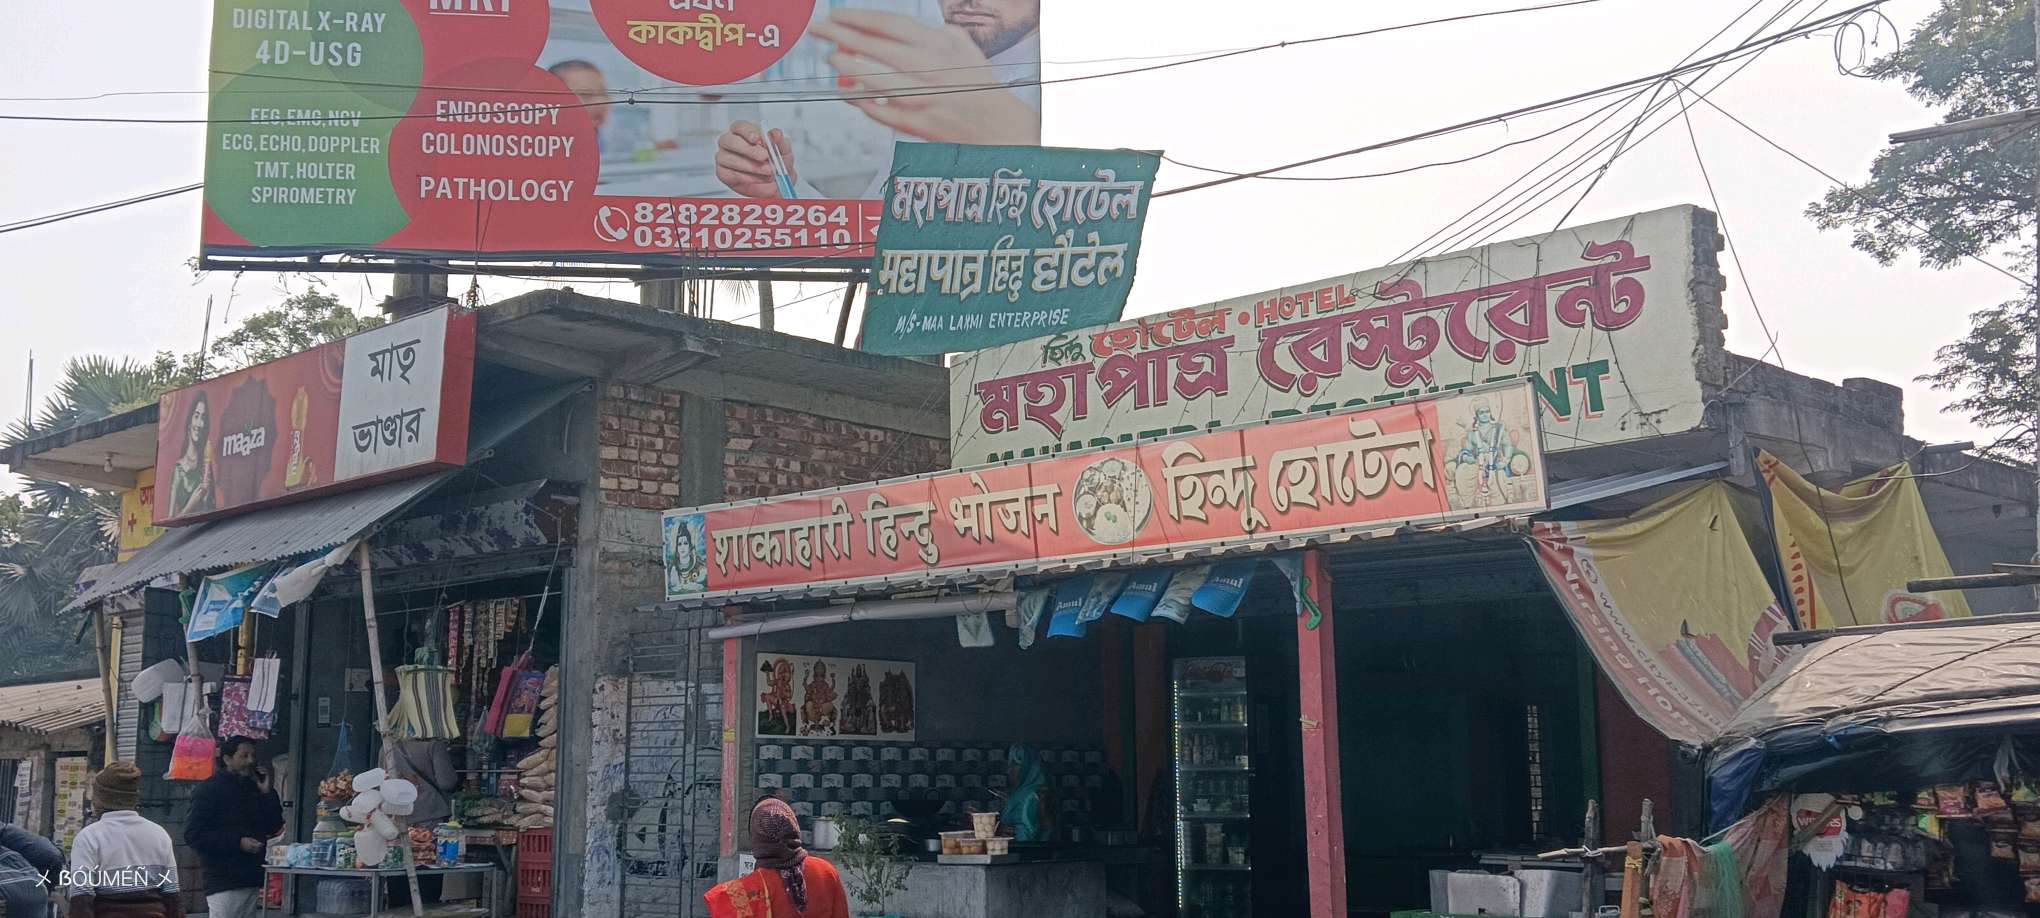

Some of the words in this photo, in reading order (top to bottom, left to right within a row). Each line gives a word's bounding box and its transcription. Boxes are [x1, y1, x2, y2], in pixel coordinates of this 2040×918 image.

[233, 8, 313, 31] DIGITAL
[317, 11, 386, 33] X-RAY
[626, 13, 780, 51] কাকদ্বীপ-এ
[256, 40, 362, 67] 4D-USG
[436, 100, 560, 125] ENDOSCOPY
[422, 132, 574, 158] COLONOSCOPY
[251, 186, 357, 205] SPIROMETRY
[420, 175, 574, 202] PATHOLOGY
[891, 176, 990, 229] মহাপাত্র
[1030, 168, 1144, 234] হোটেল
[634, 202, 849, 226] 8282829264
[634, 226, 851, 249] 03210255110
[950, 312, 982, 331] LAXMI
[989, 308, 1070, 329] ENTERPRISE
[1090, 308, 1232, 358] হোটেল
[1255, 283, 1358, 328] HOTEL
[368, 339, 421, 384] মাতৃ
[222, 425, 265, 457] maaza
[352, 407, 426, 454] ভাণ্ডার
[712, 497, 854, 575] शाकाहारी
[860, 493, 938, 566] हिन्दु
[950, 472, 1062, 543] भोजन
[1269, 417, 1436, 513] হোটেল
[1128, 581, 1158, 593] Amul
[1212, 576, 1244, 589] Amul
[1056, 598, 1082, 611] Amul
[1561, 560, 1634, 669] Nursing
[1637, 676, 1704, 736] Hom
